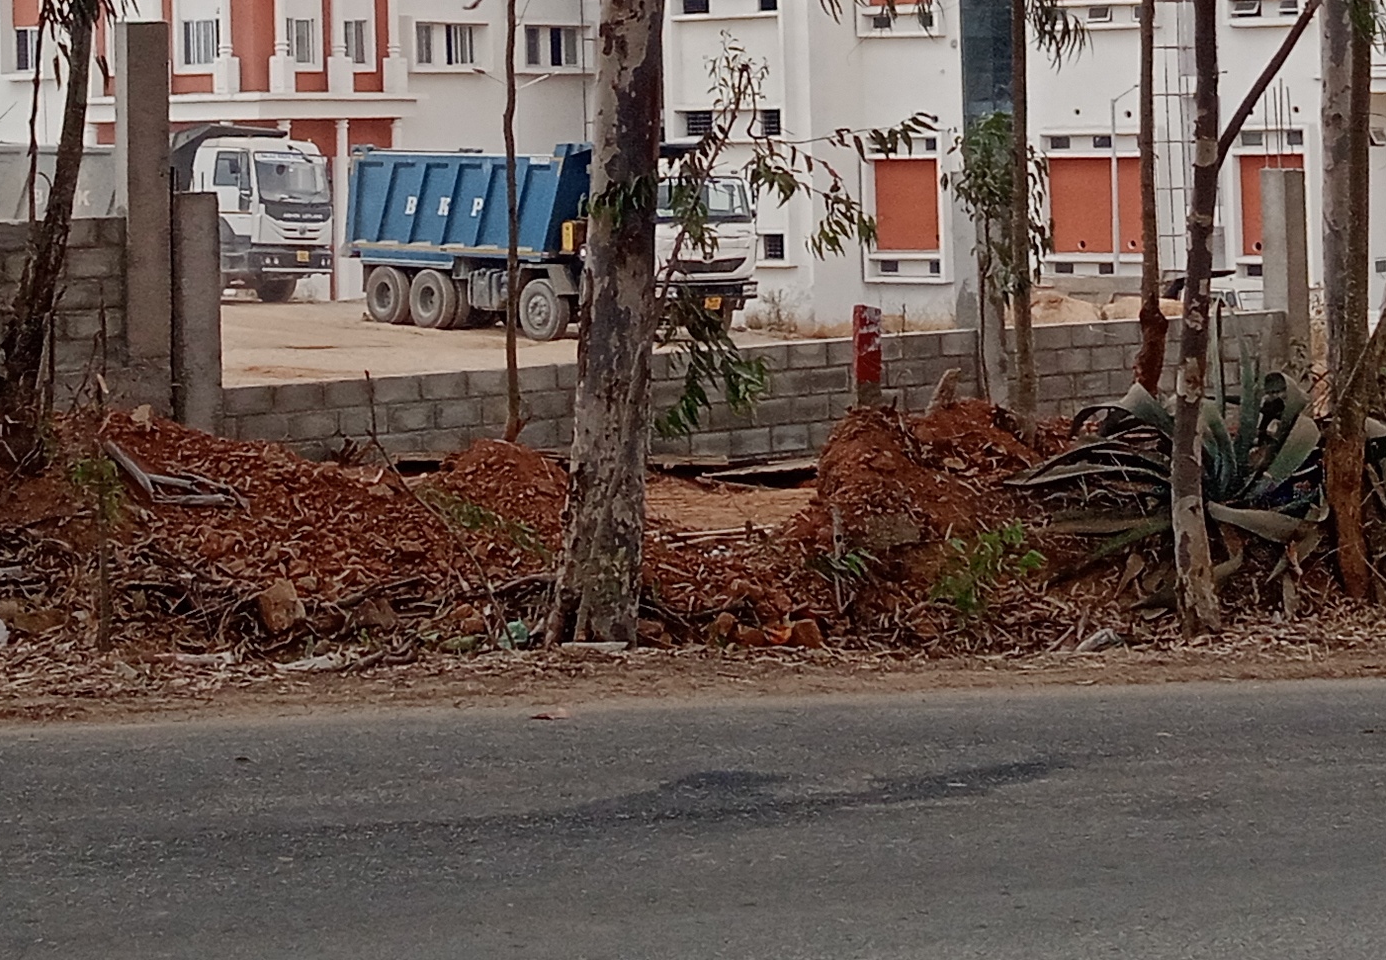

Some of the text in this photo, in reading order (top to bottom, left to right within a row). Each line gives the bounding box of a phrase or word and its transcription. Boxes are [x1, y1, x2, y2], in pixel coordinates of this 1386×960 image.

[405, 196, 484, 217] B K P
